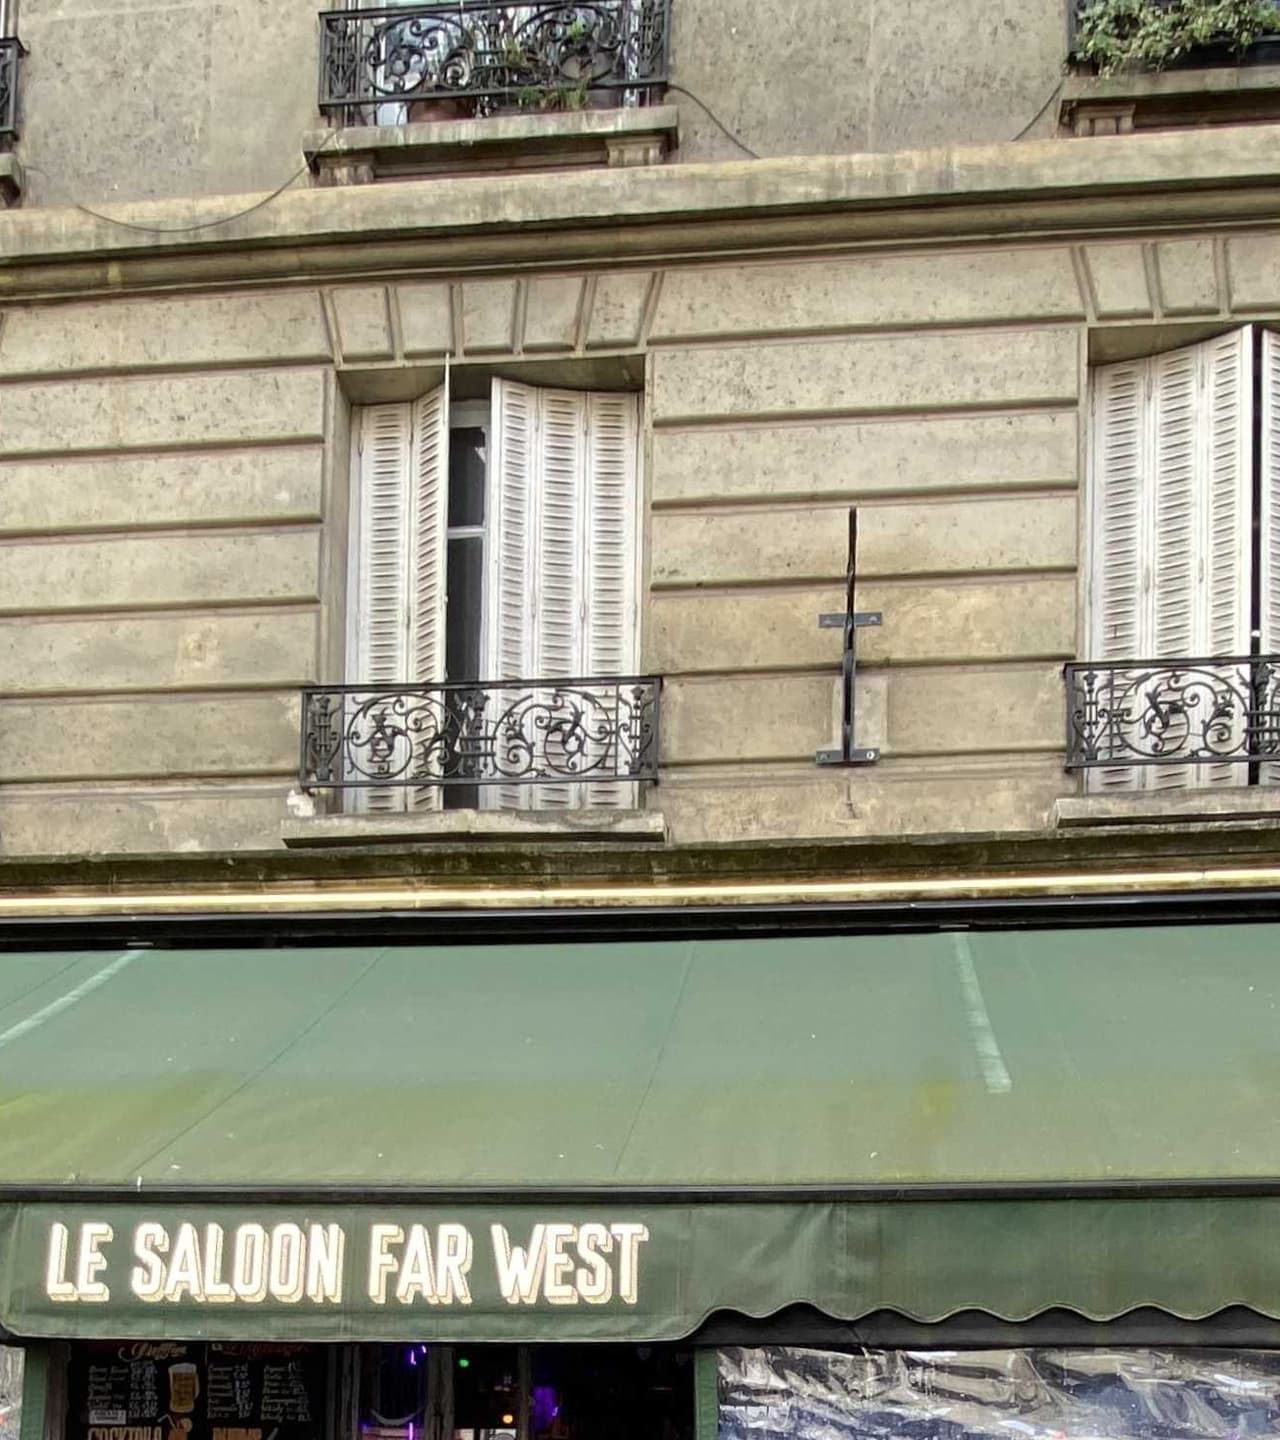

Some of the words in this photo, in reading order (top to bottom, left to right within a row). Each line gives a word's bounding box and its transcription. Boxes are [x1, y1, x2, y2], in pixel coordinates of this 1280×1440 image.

[45, 1222, 114, 1303] LE
[130, 1222, 346, 1304] SALOON
[368, 1222, 473, 1304] FAR
[490, 1222, 649, 1305] WEST
